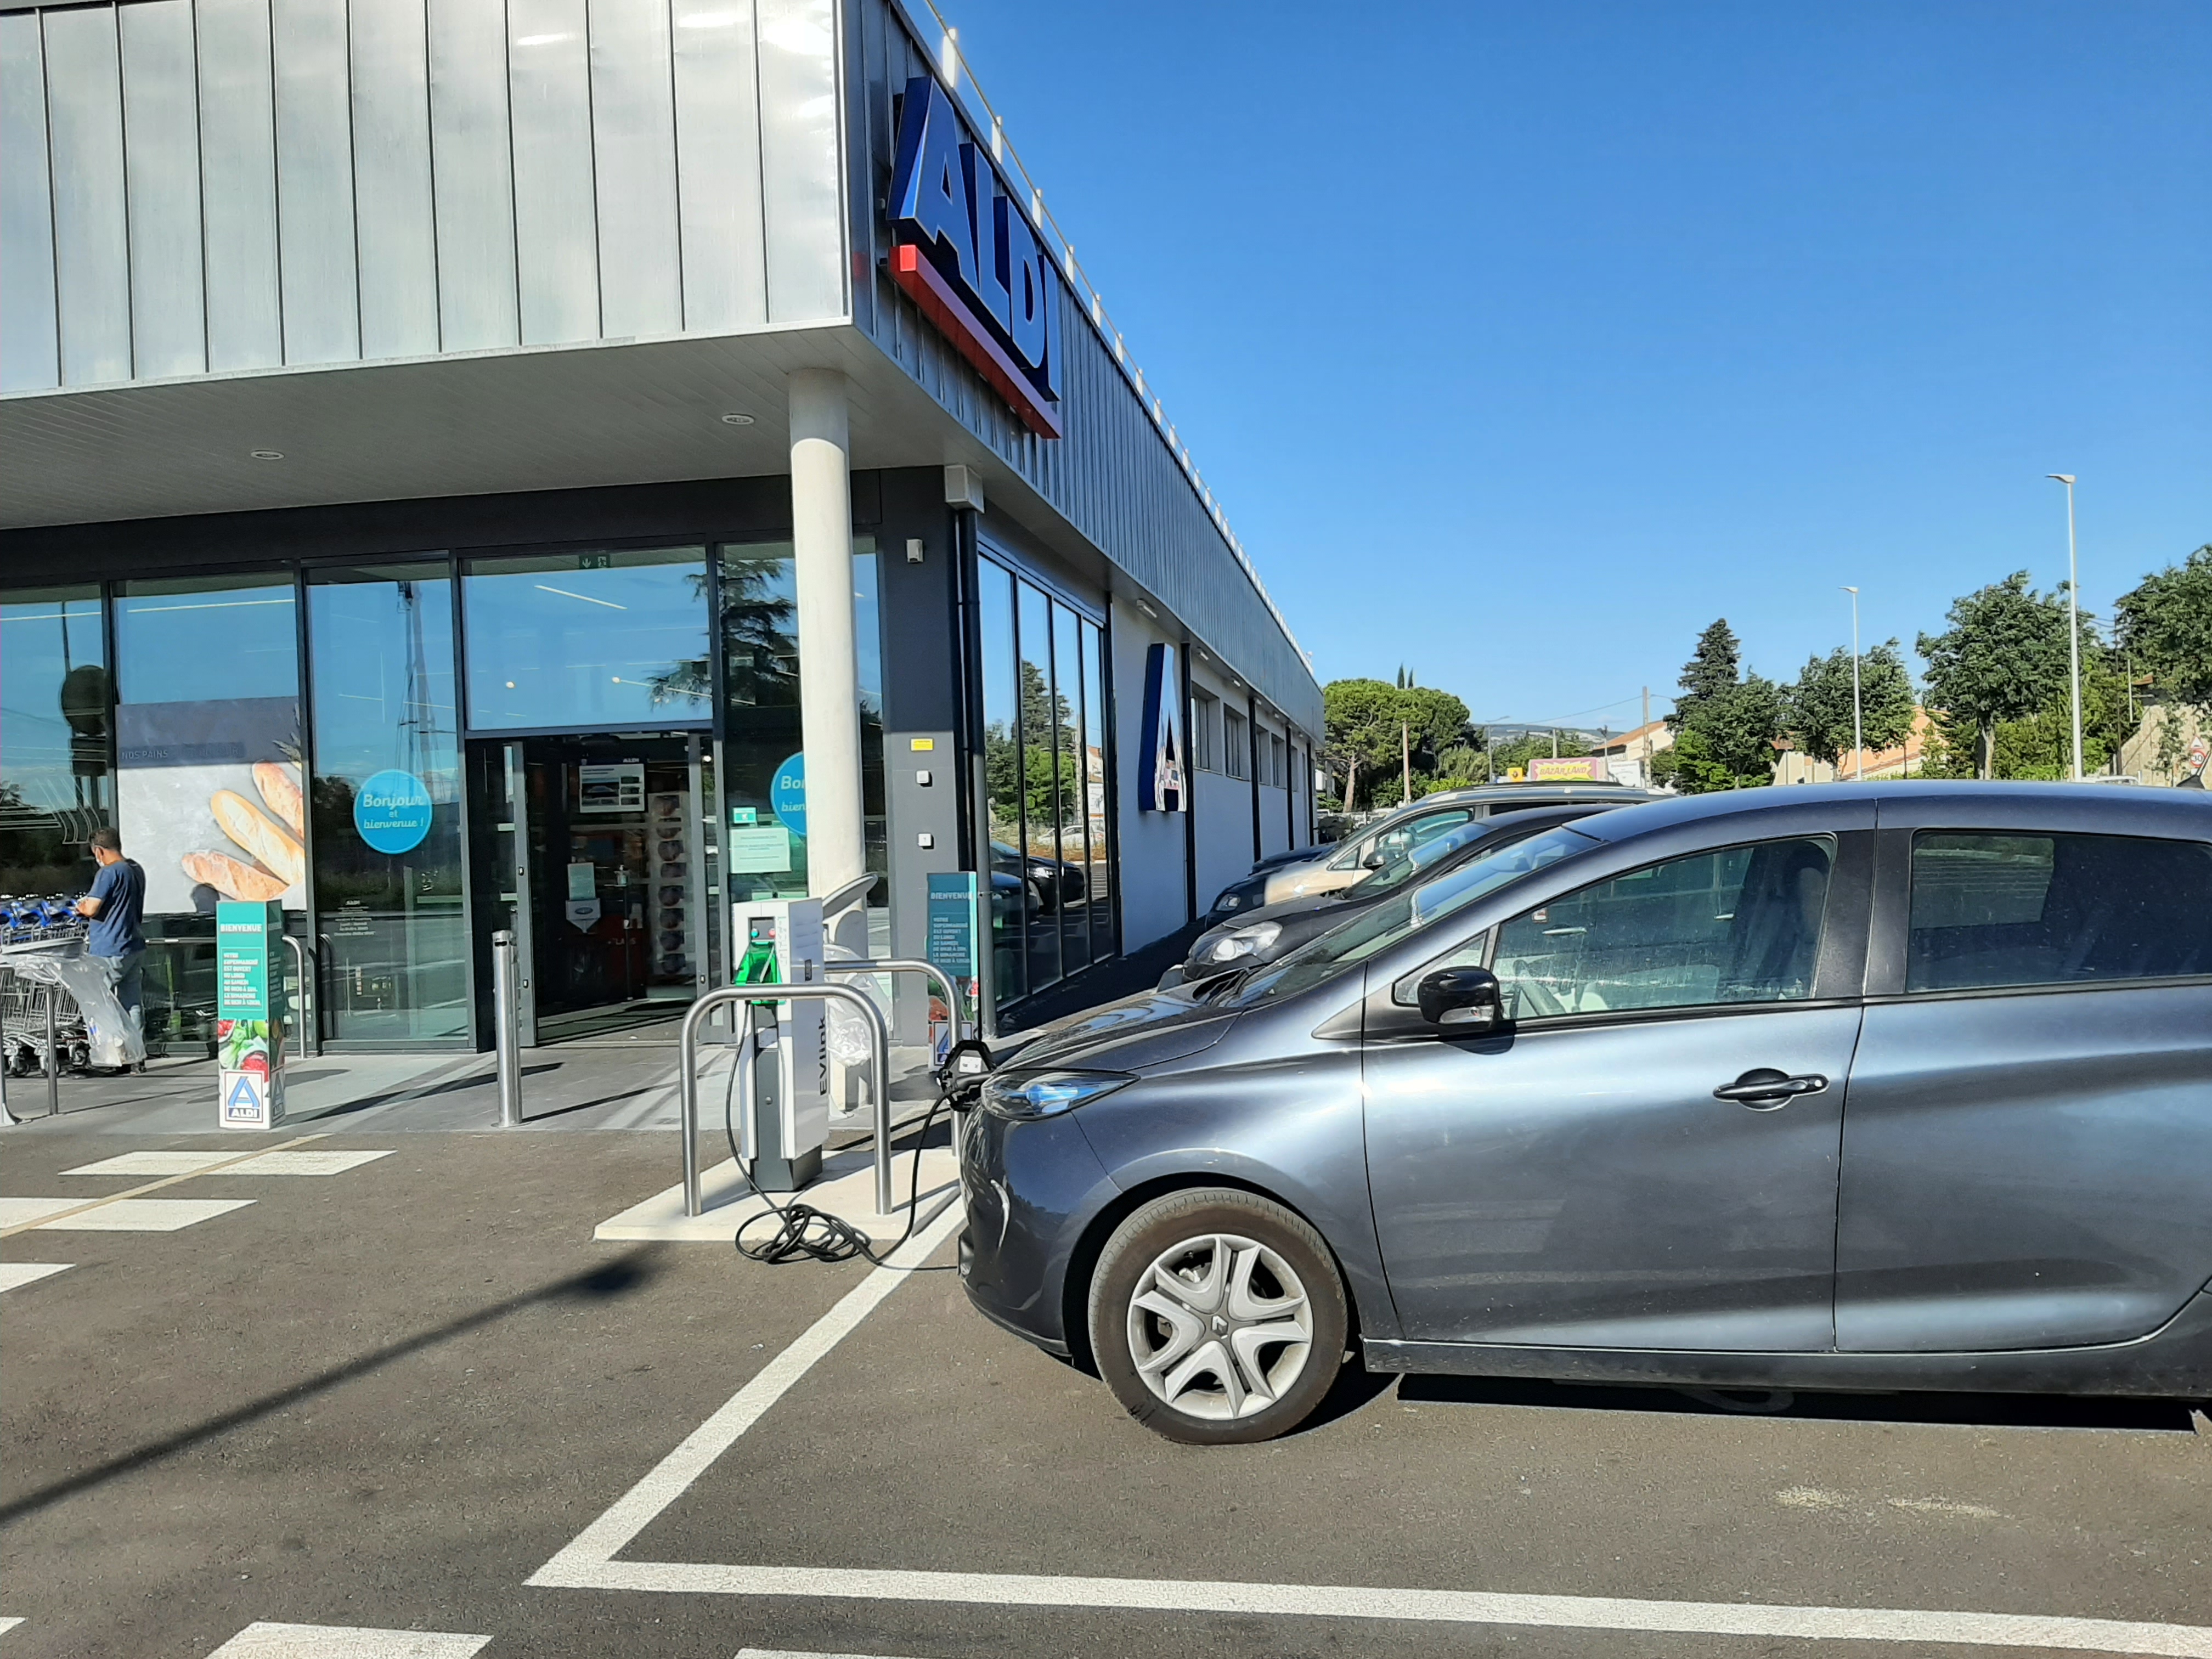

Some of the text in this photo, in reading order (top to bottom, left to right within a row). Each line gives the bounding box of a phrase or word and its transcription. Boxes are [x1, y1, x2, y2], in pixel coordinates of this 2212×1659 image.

[896, 74, 1060, 402] ALDI
[122, 750, 168, 760] NOS PAINS
[1539, 767, 1564, 775] BAZAR
[363, 793, 425, 810] Bonjour
[388, 809, 398, 818] et
[364, 819, 418, 829] bienvenue
[930, 891, 973, 900] BIENVENUE
[220, 923, 262, 933] BIENVENUE
[230, 1108, 258, 1118] ALDI
